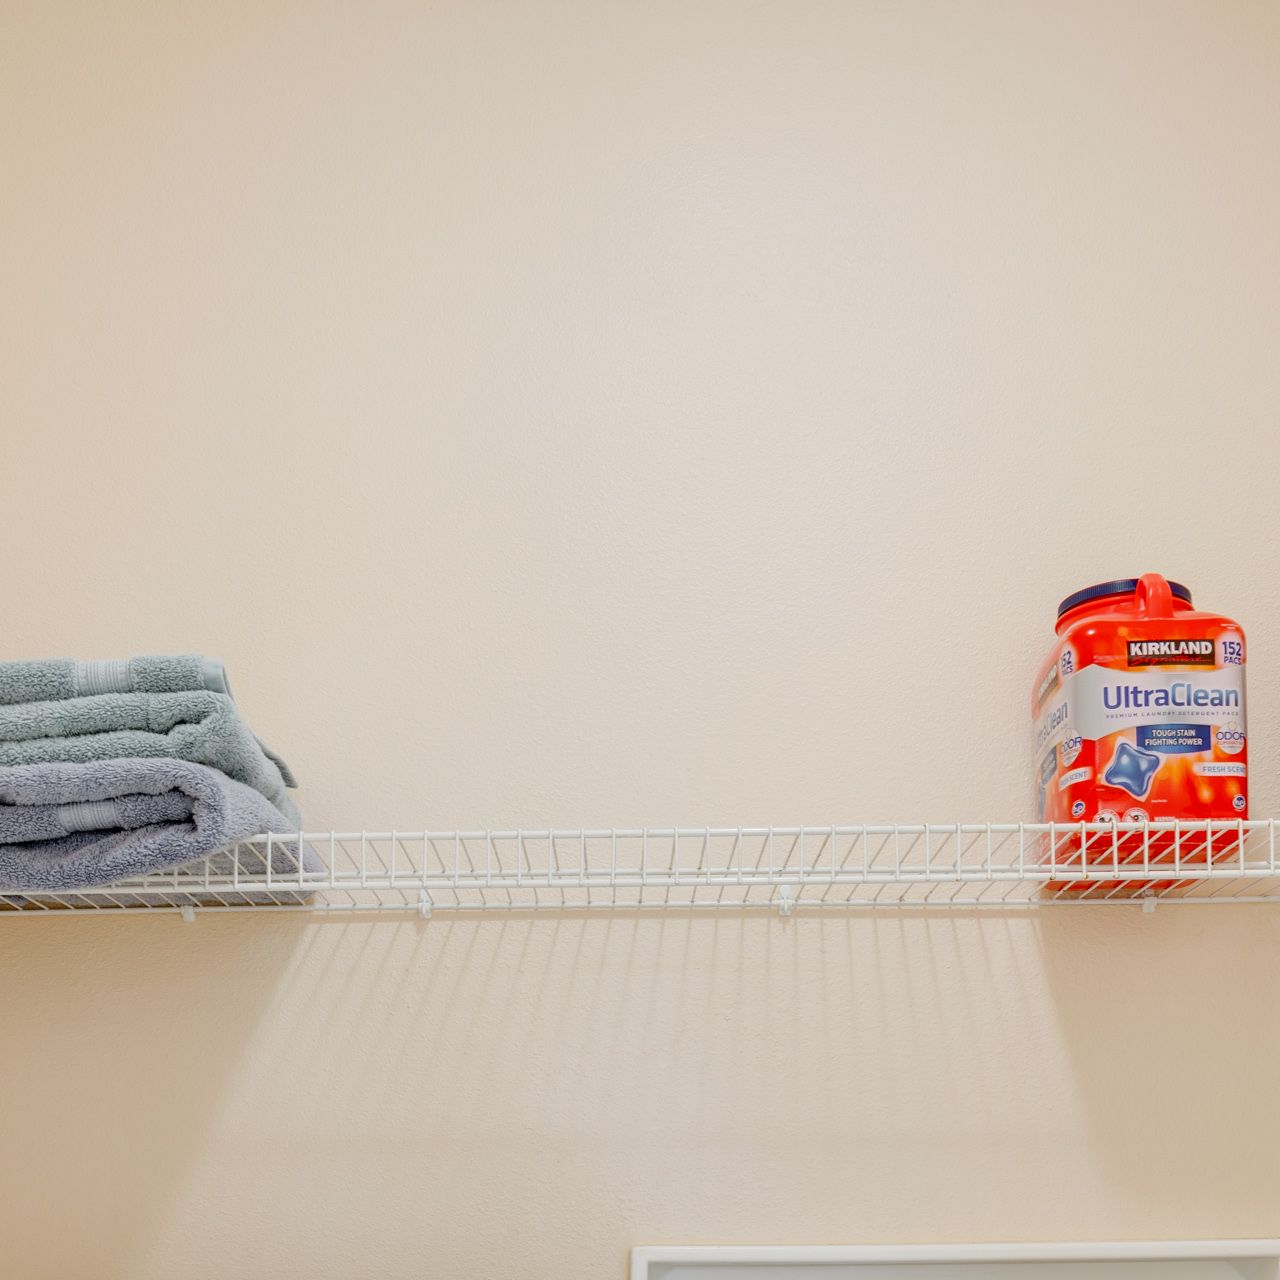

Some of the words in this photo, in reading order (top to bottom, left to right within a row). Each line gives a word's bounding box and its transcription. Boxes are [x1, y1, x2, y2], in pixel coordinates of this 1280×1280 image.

[1130, 642, 1213, 656] KIRKLAND
[1222, 641, 1242, 657] 152
[1224, 656, 1242, 666] PACS
[1103, 683, 1239, 710] UltraClean
[1152, 729, 1176, 737] TOUGH
[1177, 729, 1196, 737] STAIN
[1145, 738, 1178, 746] FIGHTING
[1179, 738, 1203, 746] POWER
